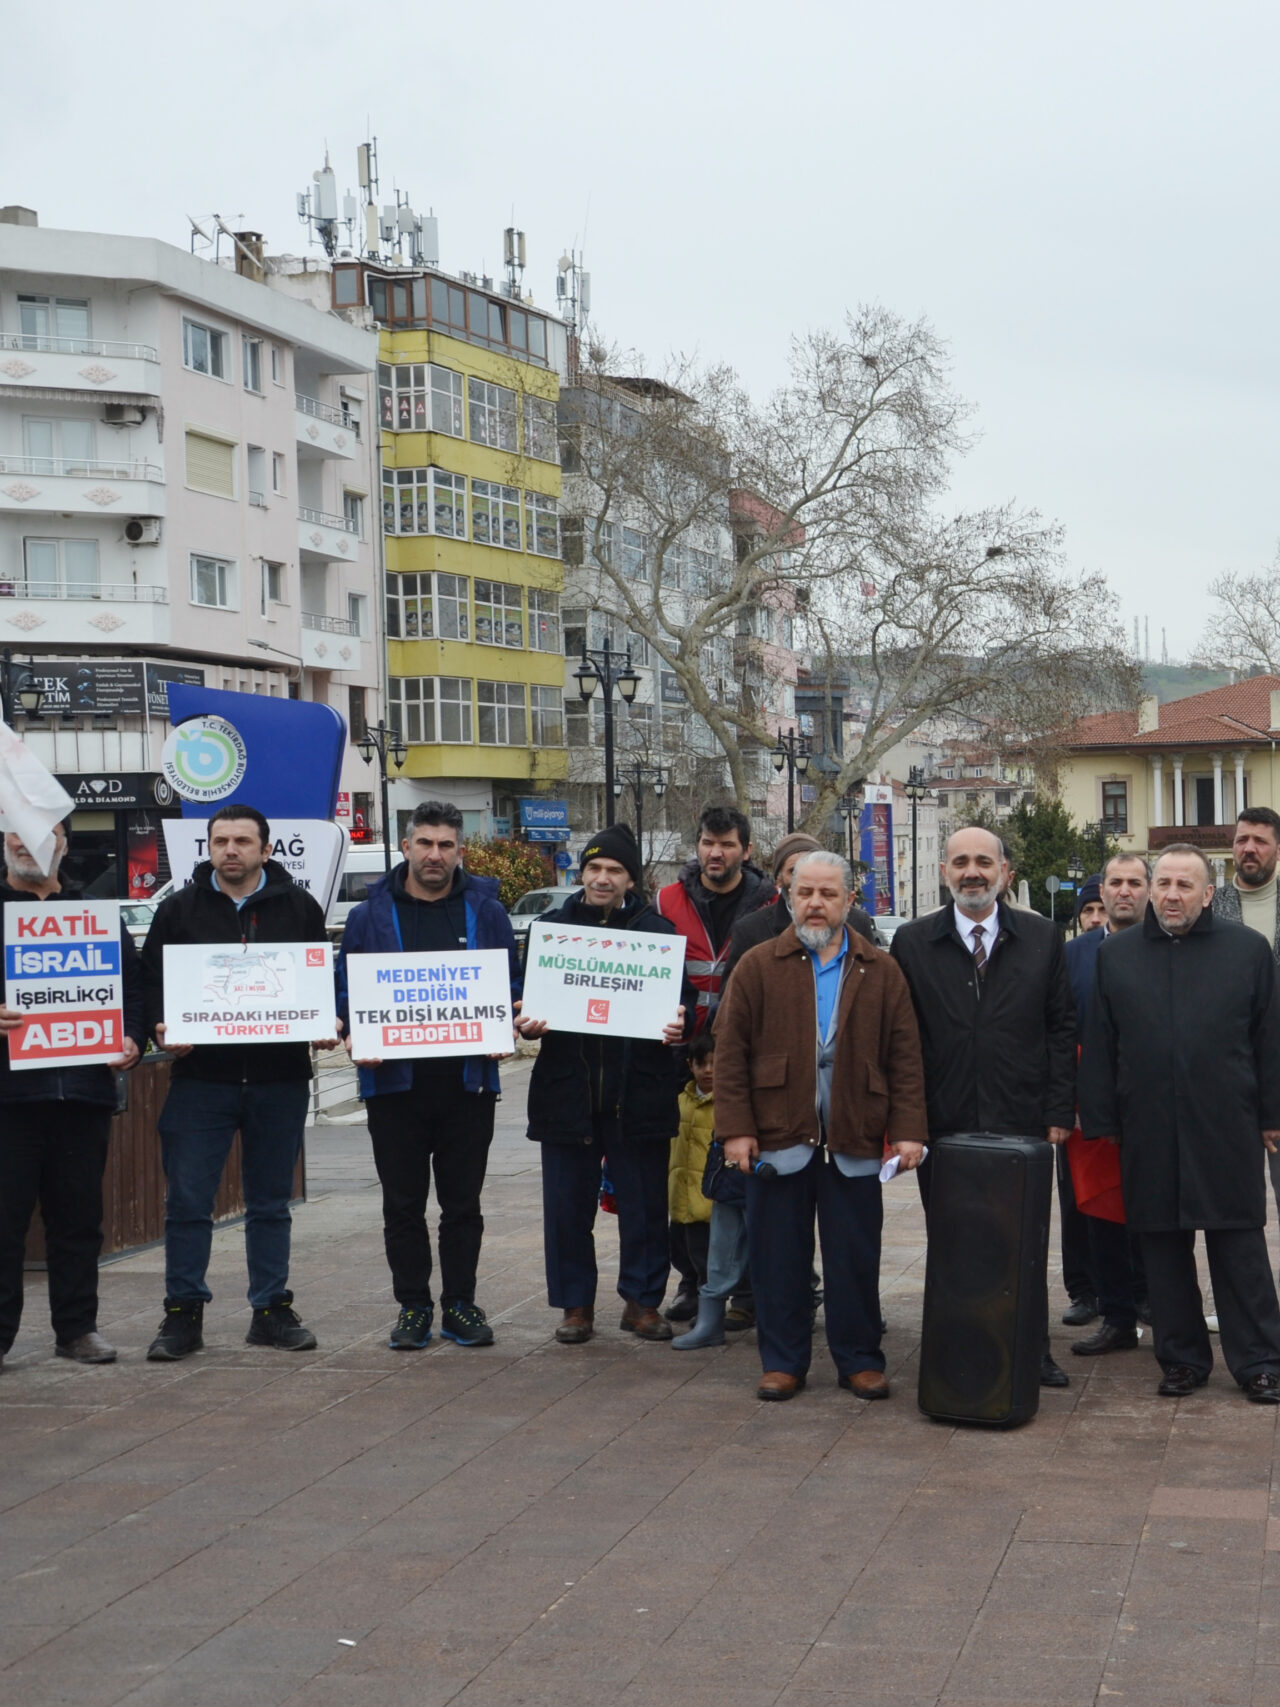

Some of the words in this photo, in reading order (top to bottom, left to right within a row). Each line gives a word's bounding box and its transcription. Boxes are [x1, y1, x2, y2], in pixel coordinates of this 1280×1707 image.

[202, 721, 216, 729] T.C.
[219, 725, 246, 761] TEKİRDAĞ
[164, 762, 200, 796] BELEDİYESİ
[202, 762, 245, 798] BÜYÜKŞEHİR
[18, 909, 108, 937] KATİL
[14, 944, 113, 975] İSRAİL
[538, 953, 671, 980] MÜSLÜMANLAR
[376, 964, 482, 983] MEDENİYET
[16, 984, 113, 1009] İŞBİRLİKÇİ
[393, 983, 468, 1003] DEDİĞİN
[265, 1009, 320, 1021] HEDEF
[355, 1009, 391, 1024] TEK
[396, 1004, 432, 1025] DİŞİ
[437, 1005, 506, 1022] KALMIŞ
[21, 1019, 114, 1051] ABD!
[387, 1025, 478, 1044] PEDOFİLİ!
